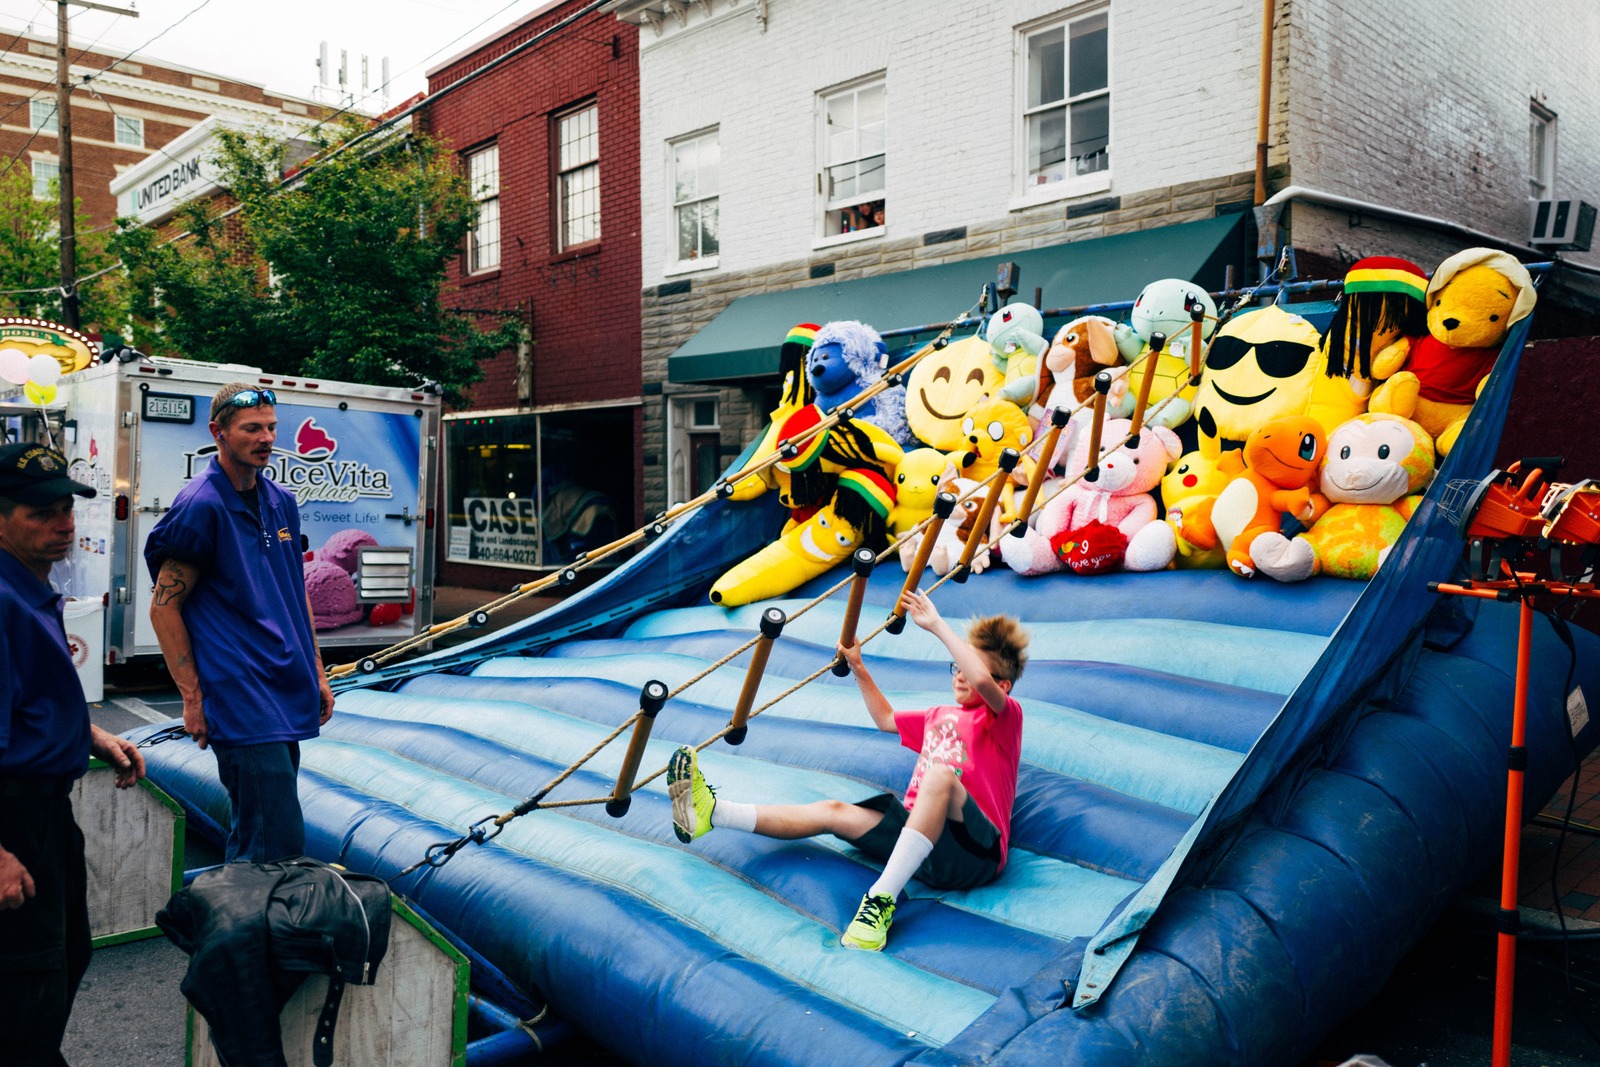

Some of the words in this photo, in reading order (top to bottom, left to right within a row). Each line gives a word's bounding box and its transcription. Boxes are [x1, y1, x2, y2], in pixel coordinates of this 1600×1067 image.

[138, 174, 172, 210] UNITED
[172, 155, 201, 191] BANK
[297, 482, 361, 503] gelato
[313, 511, 351, 523] Sweet
[355, 512, 380, 524] Life!
[468, 499, 536, 535] CASE
[499, 537, 539, 549] Landscaping
